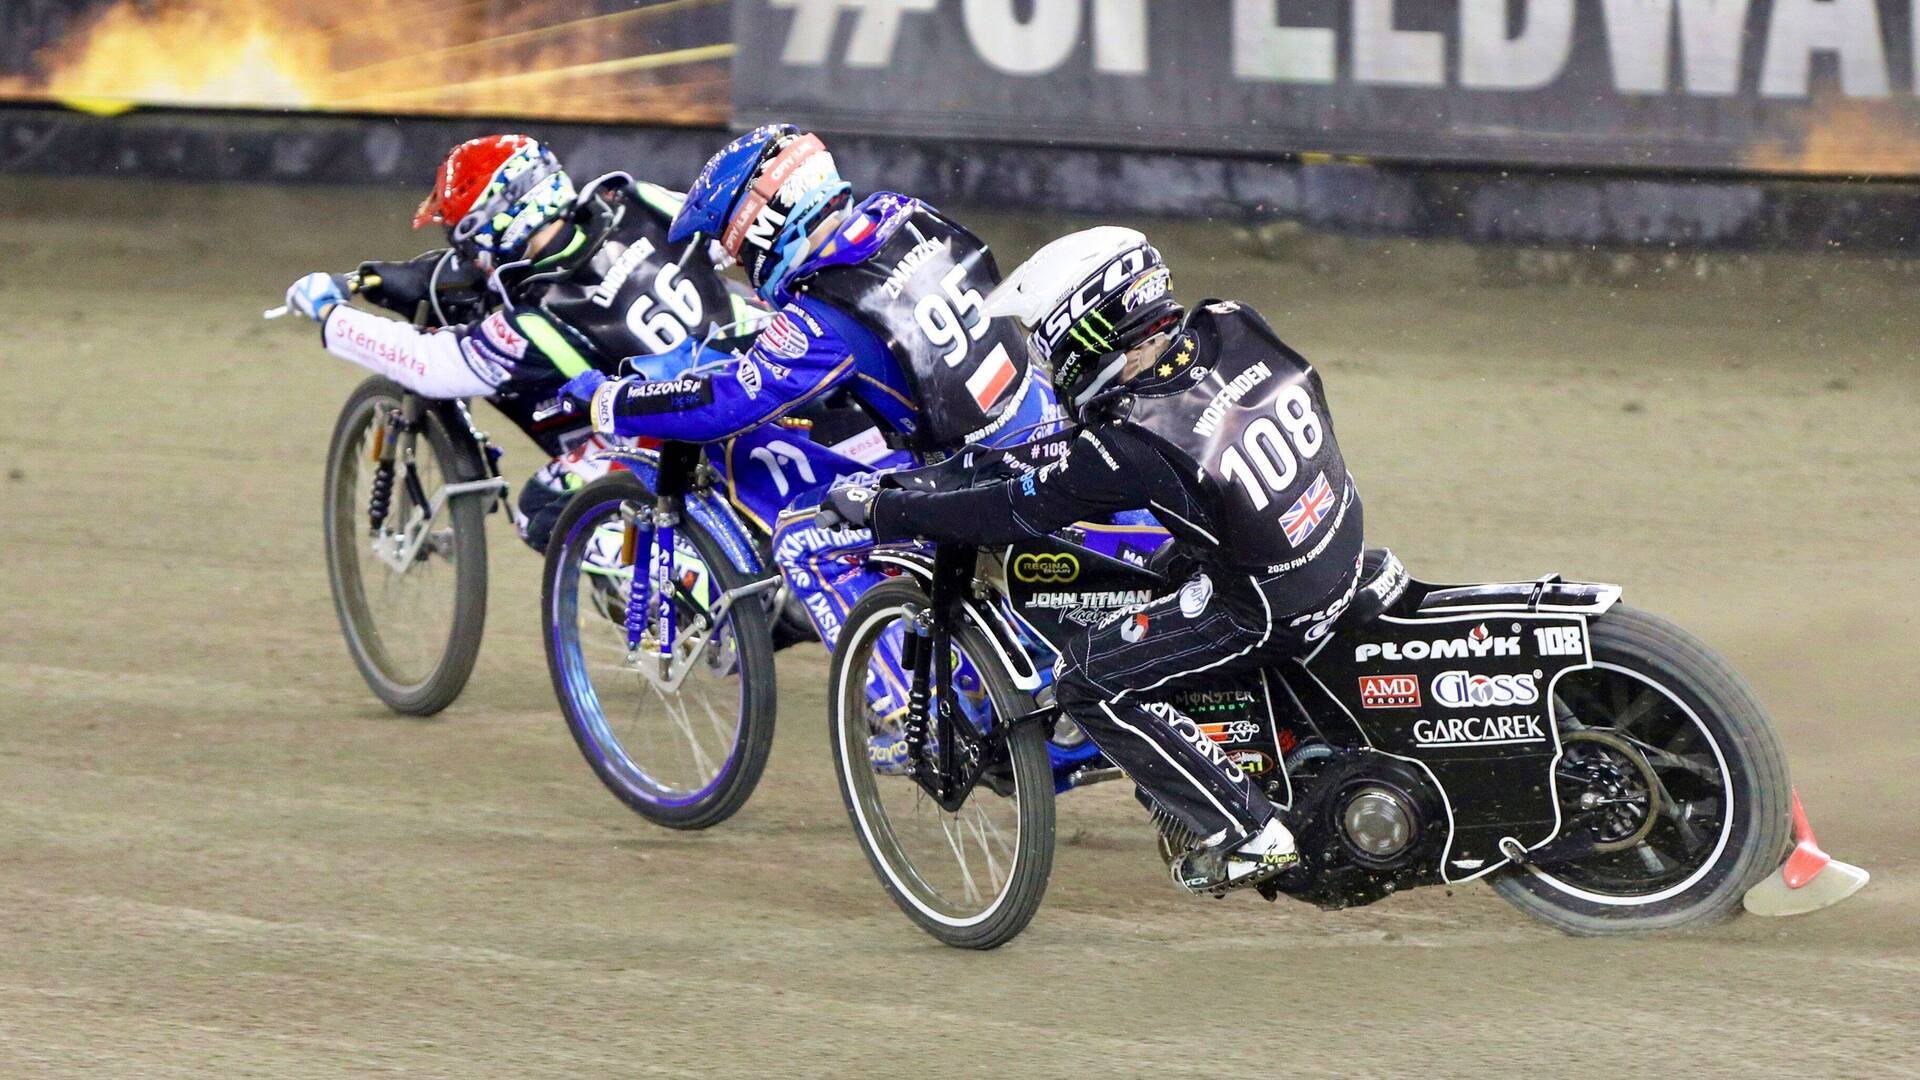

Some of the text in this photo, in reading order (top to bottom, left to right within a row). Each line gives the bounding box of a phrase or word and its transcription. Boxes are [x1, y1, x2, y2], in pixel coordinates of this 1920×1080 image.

[626, 263, 703, 354] 66
[914, 264, 991, 368] 95
[1193, 361, 1273, 438] WOFFINDEN
[1219, 384, 1323, 512] 108
[1024, 562, 1070, 570] REGINA
[1268, 563, 1290, 575] 2020
[1291, 555, 1308, 569] FIM
[1025, 590, 1152, 609] JOHN TITMAN
[1055, 602, 1110, 627] Racin
[1533, 626, 1583, 656] 108
[1363, 677, 1417, 697] AMD
[1366, 696, 1415, 704] GROUP
[1413, 715, 1546, 743] GARCAREK
